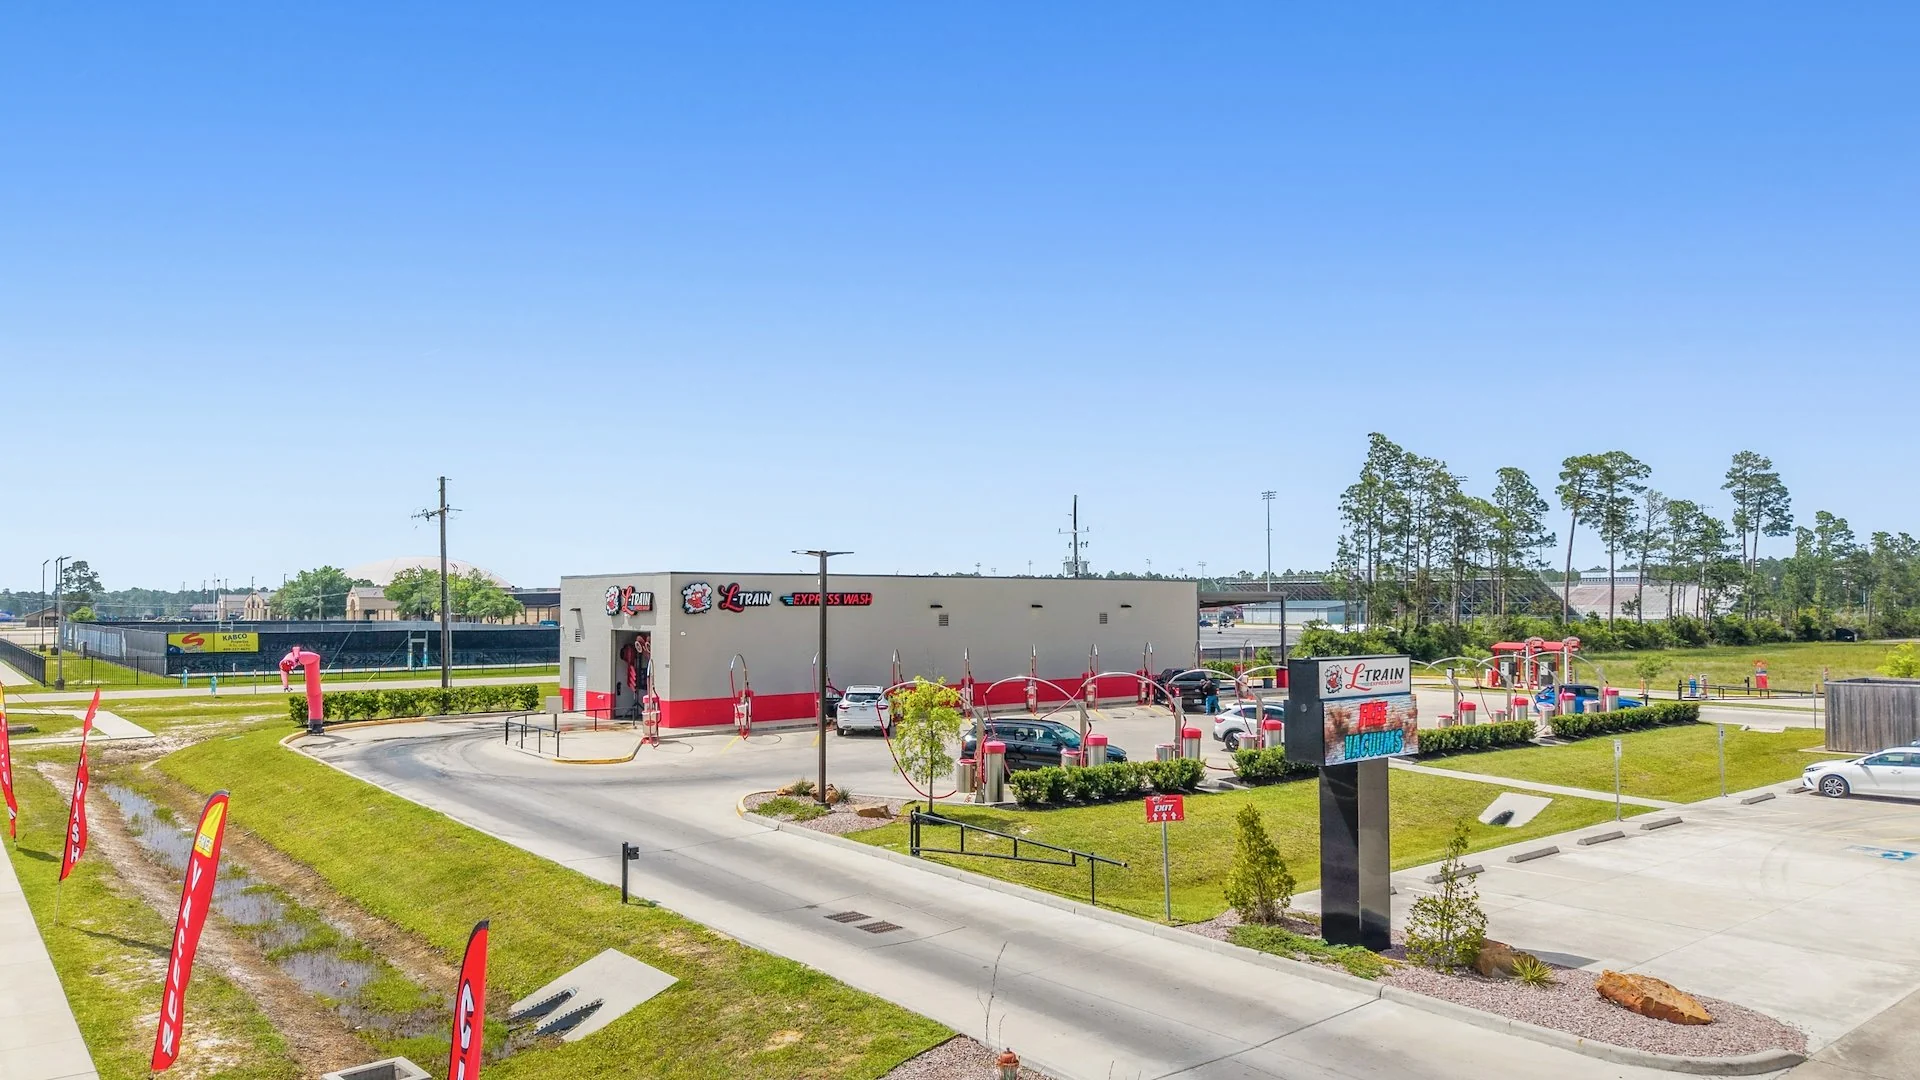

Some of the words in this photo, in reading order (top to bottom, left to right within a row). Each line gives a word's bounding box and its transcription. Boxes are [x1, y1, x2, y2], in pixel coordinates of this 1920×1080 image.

[622, 585, 651, 616] L-TRAIN
[719, 583, 772, 612] L-TRAIN
[794, 593, 840, 605] EXPRSS
[843, 593, 874, 605] WASH
[222, 633, 247, 641] KABCO
[1344, 663, 1404, 691] L-TRAIN
[1345, 728, 1403, 760] VACUUMS
[1154, 804, 1174, 812] EXIT
